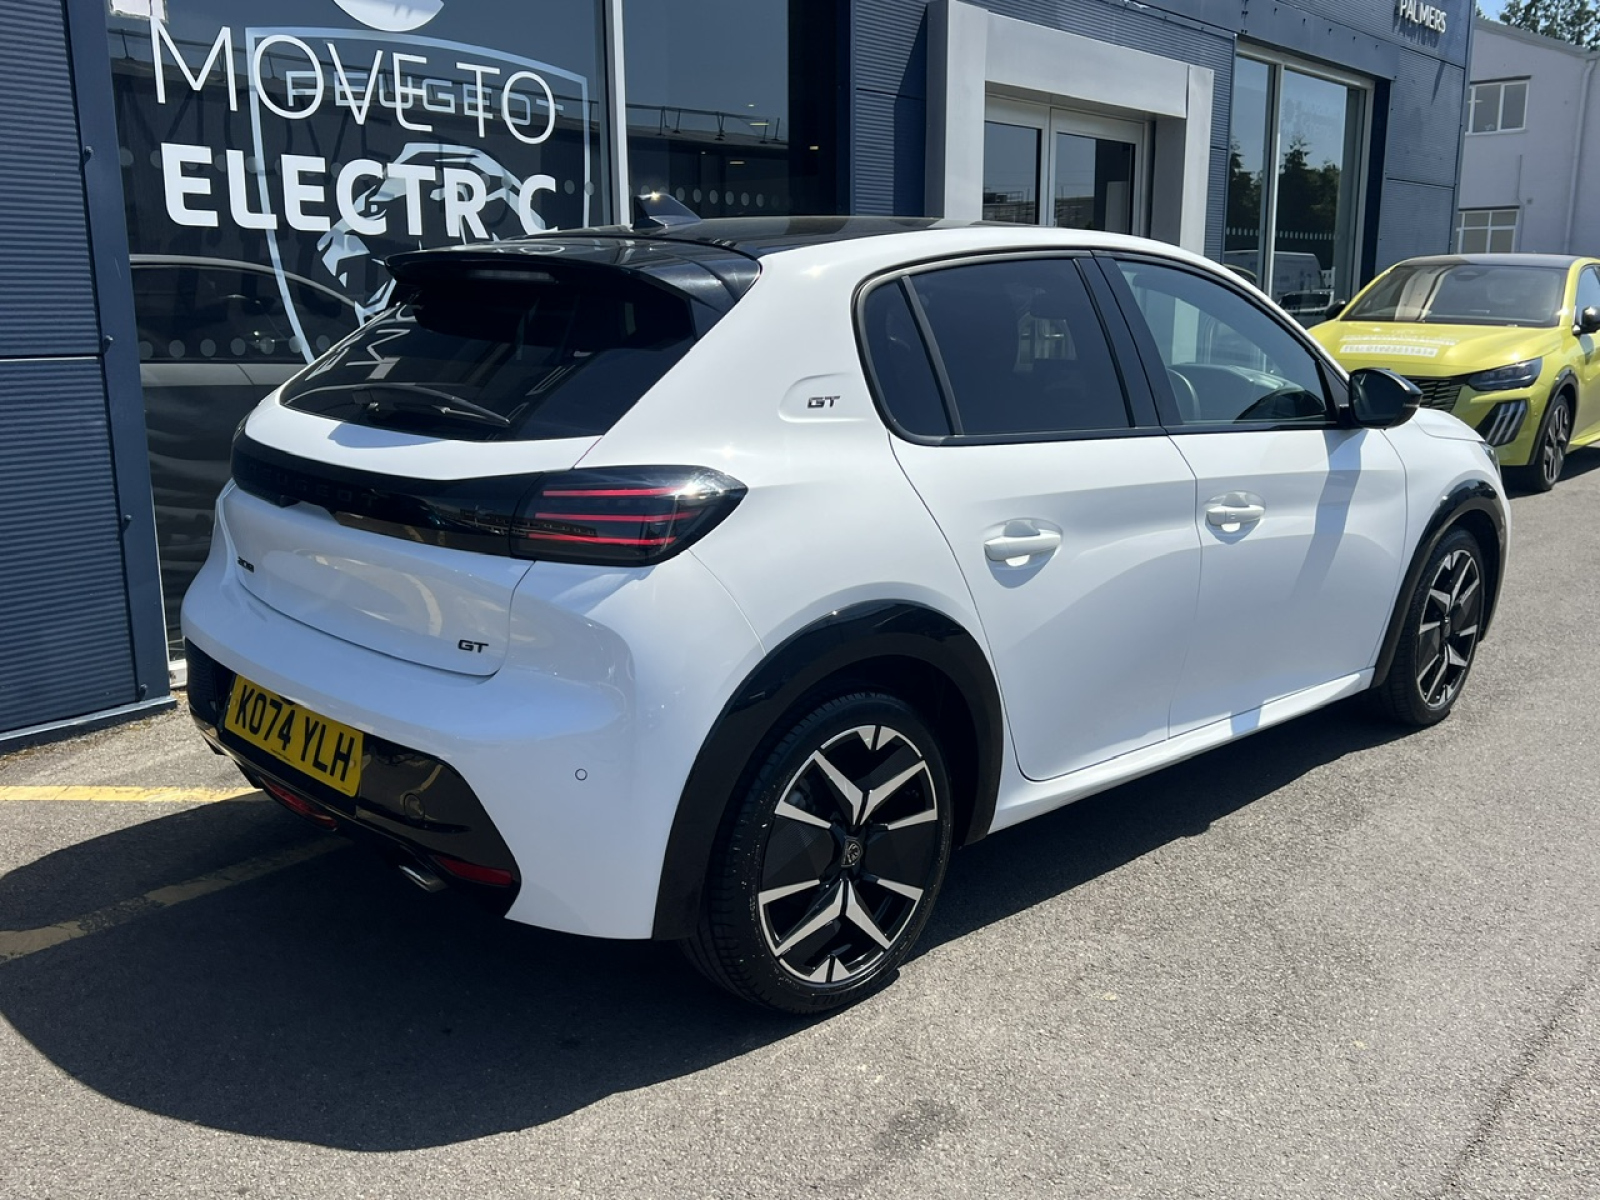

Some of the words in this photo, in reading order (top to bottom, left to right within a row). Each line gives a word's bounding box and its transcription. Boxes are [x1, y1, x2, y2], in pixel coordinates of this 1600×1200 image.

[1400, 0, 1447, 33] PALMERS
[150, 17, 433, 132] MOVE
[456, 62, 556, 145] TO
[285, 70, 565, 126] PEUGEOT
[161, 142, 559, 239] ELECTRC
[807, 395, 841, 409] GT
[458, 639, 489, 654] GT
[234, 684, 296, 752] KO74
[300, 715, 356, 783] YLH
